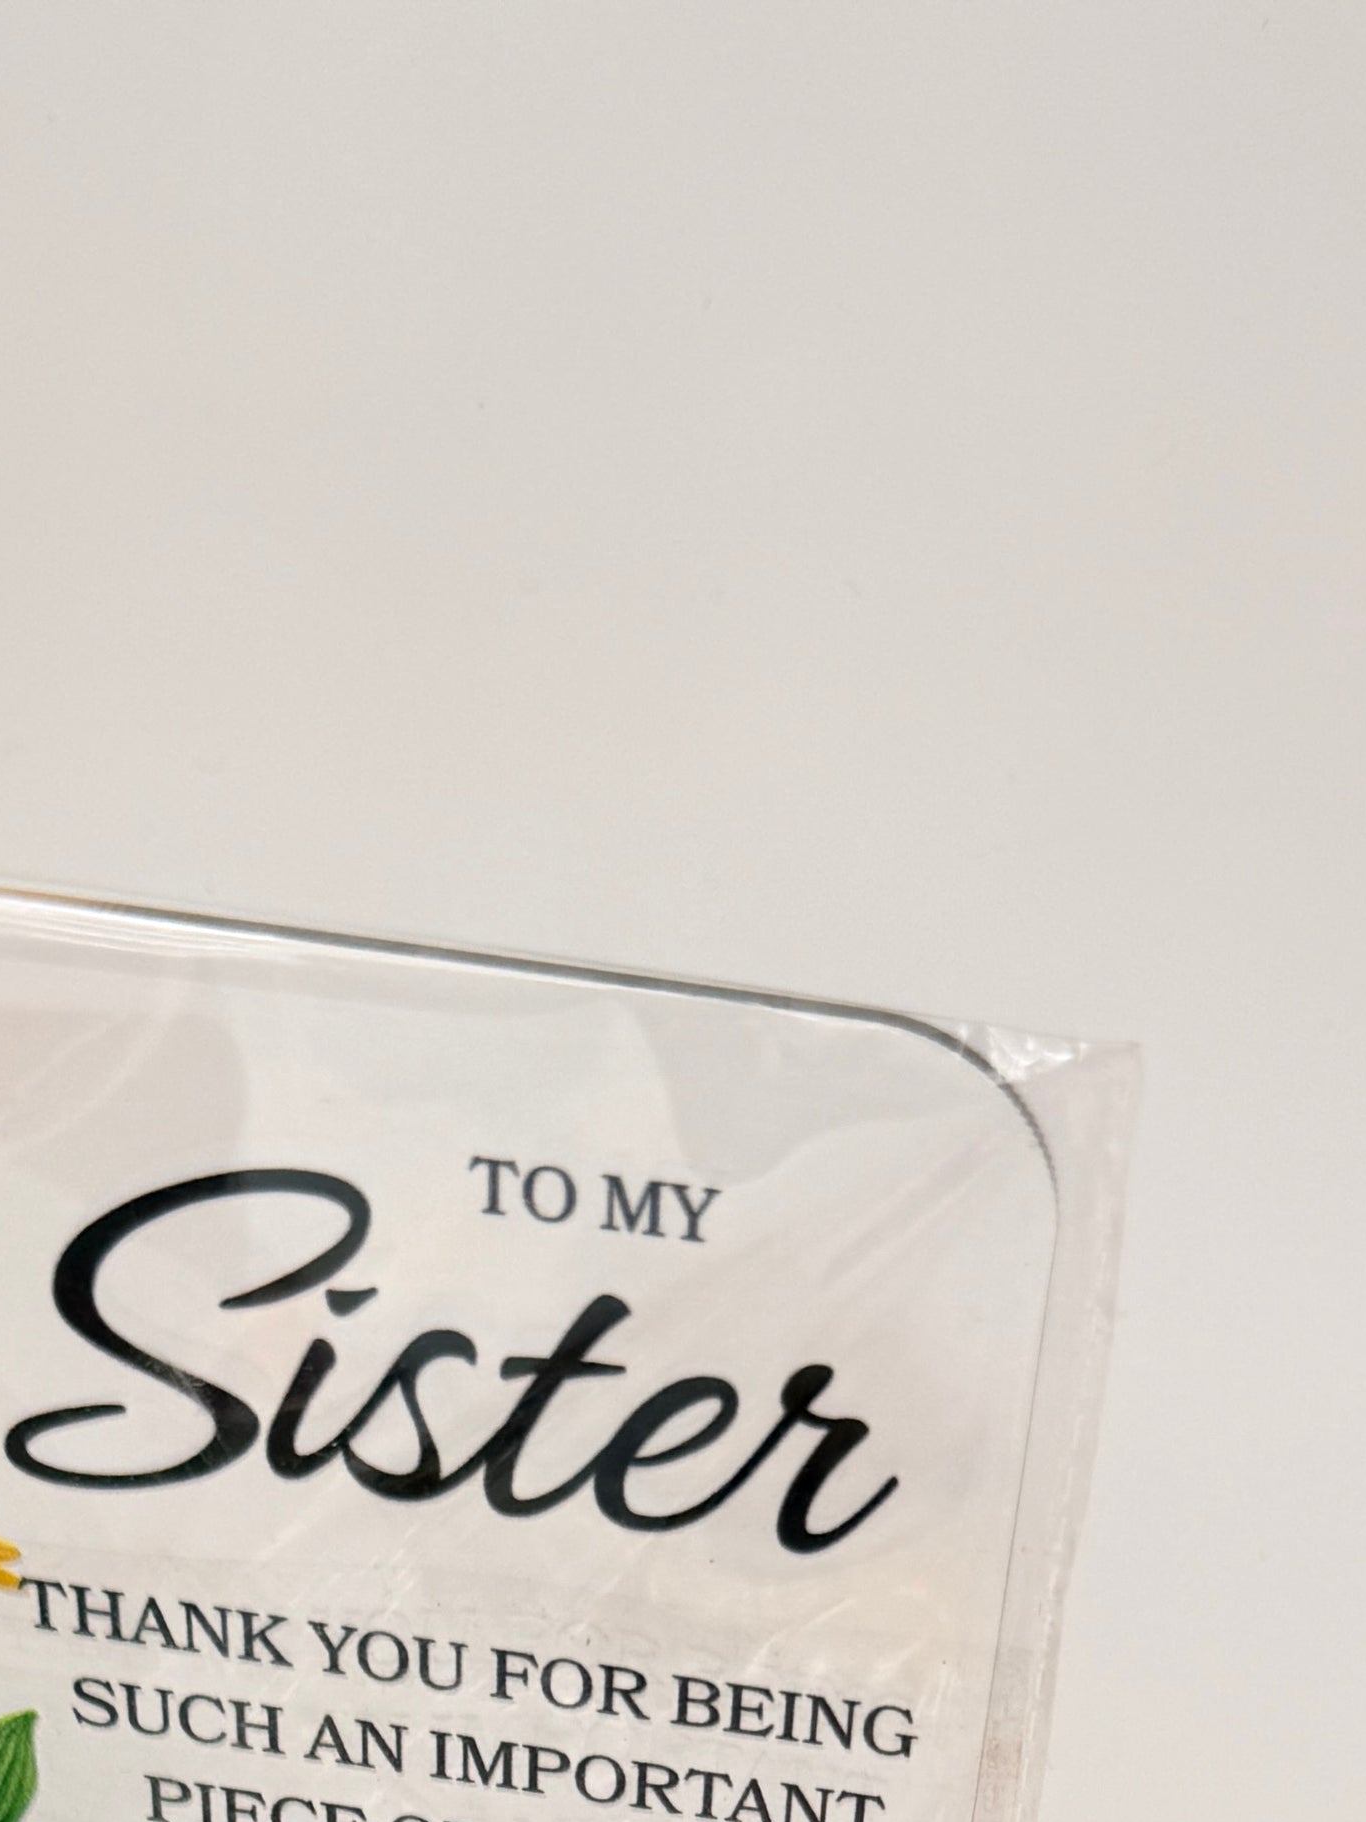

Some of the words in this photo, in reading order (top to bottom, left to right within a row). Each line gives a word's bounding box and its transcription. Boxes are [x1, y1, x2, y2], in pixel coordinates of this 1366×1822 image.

[470, 1155, 577, 1224] TO
[599, 1173, 722, 1243] MY
[2, 1167, 900, 1556] Sister
[16, 1575, 294, 1668] THANK
[307, 1619, 469, 1692] YOU
[489, 1647, 651, 1722] FOR
[669, 1673, 919, 1760] BEING
[70, 1675, 286, 1756] SUCH
[301, 1712, 410, 1775] AN
